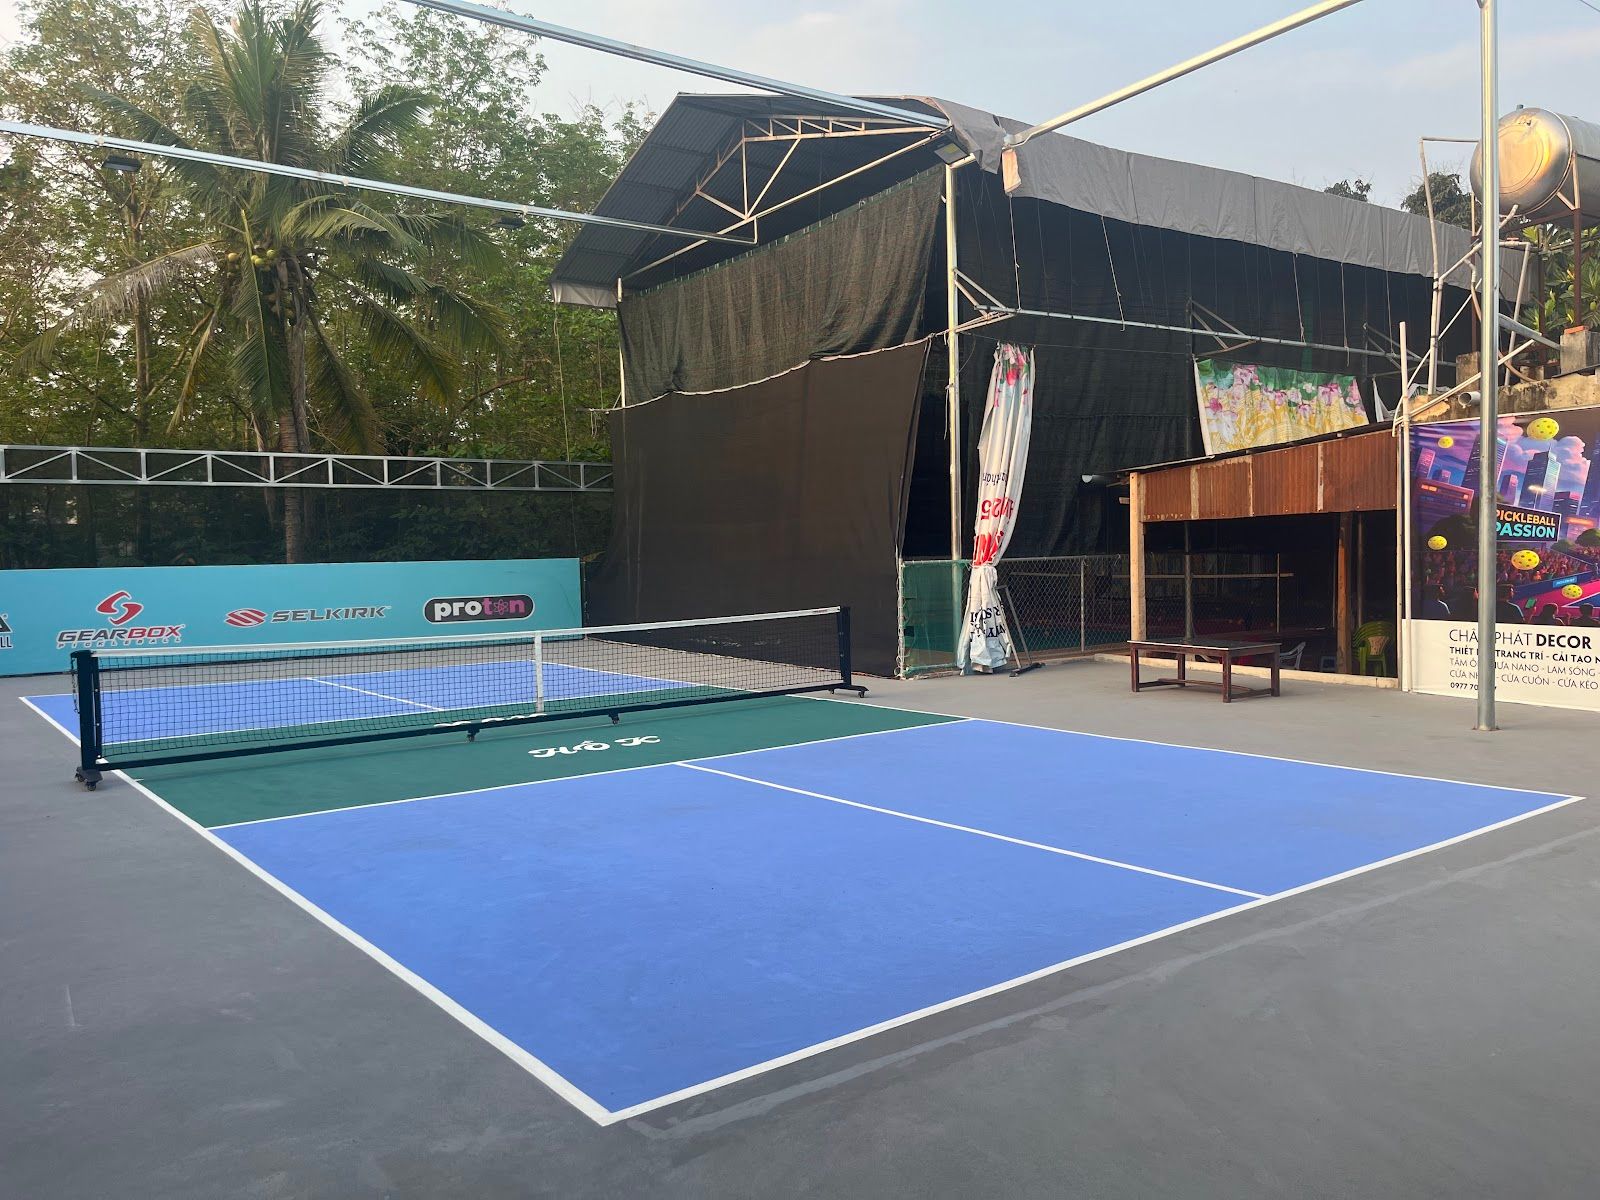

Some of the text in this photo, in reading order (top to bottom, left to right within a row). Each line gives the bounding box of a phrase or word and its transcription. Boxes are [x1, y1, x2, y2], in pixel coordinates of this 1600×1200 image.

[271, 606, 385, 623] SELKIRK
[57, 625, 181, 643] GEARBOX
[1449, 628, 1479, 642] CHÂ
[1536, 633, 1592, 649] DECOR
[57, 638, 182, 648] PICKLEBALL
[1495, 650, 1526, 659] TRANG
[1529, 651, 1544, 660] TRÍ
[1511, 663, 1539, 672] NANO
[1547, 665, 1566, 674] LAM
[1450, 682, 1468, 690] 0977
